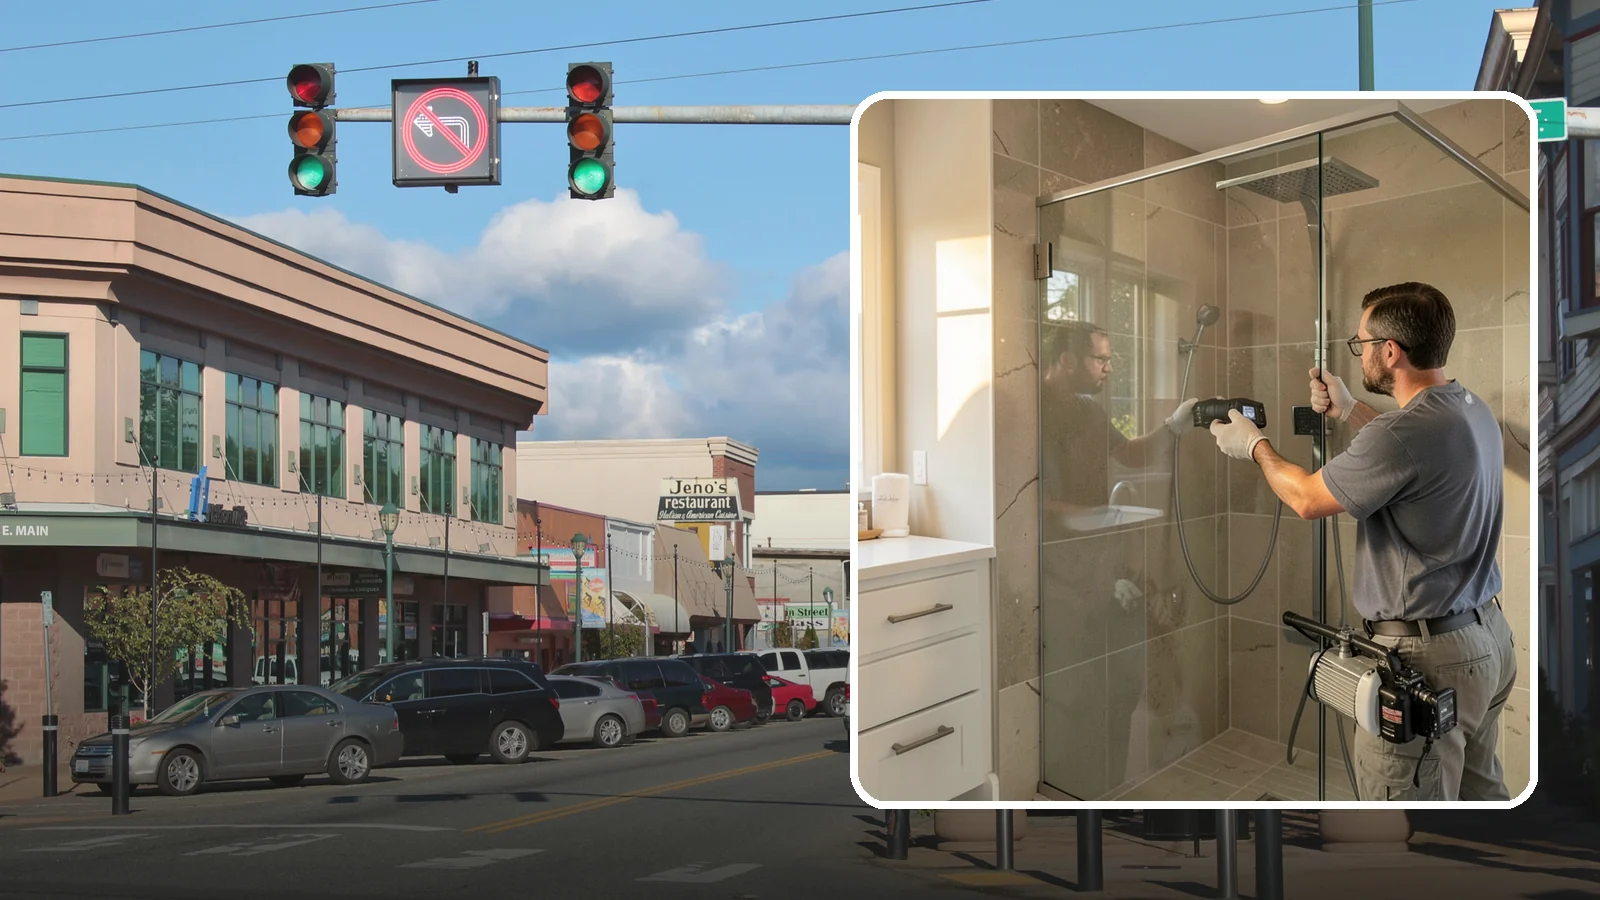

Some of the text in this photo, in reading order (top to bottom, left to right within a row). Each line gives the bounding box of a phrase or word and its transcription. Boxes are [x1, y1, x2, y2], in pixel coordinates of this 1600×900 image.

[669, 480, 728, 495] Jeno's
[665, 496, 731, 509] restaurant
[658, 509, 681, 519] Italian
[686, 509, 714, 519] American
[715, 509, 738, 519] Cuisine
[2, 525, 49, 536] E. MAIN
[797, 607, 828, 617] Street
